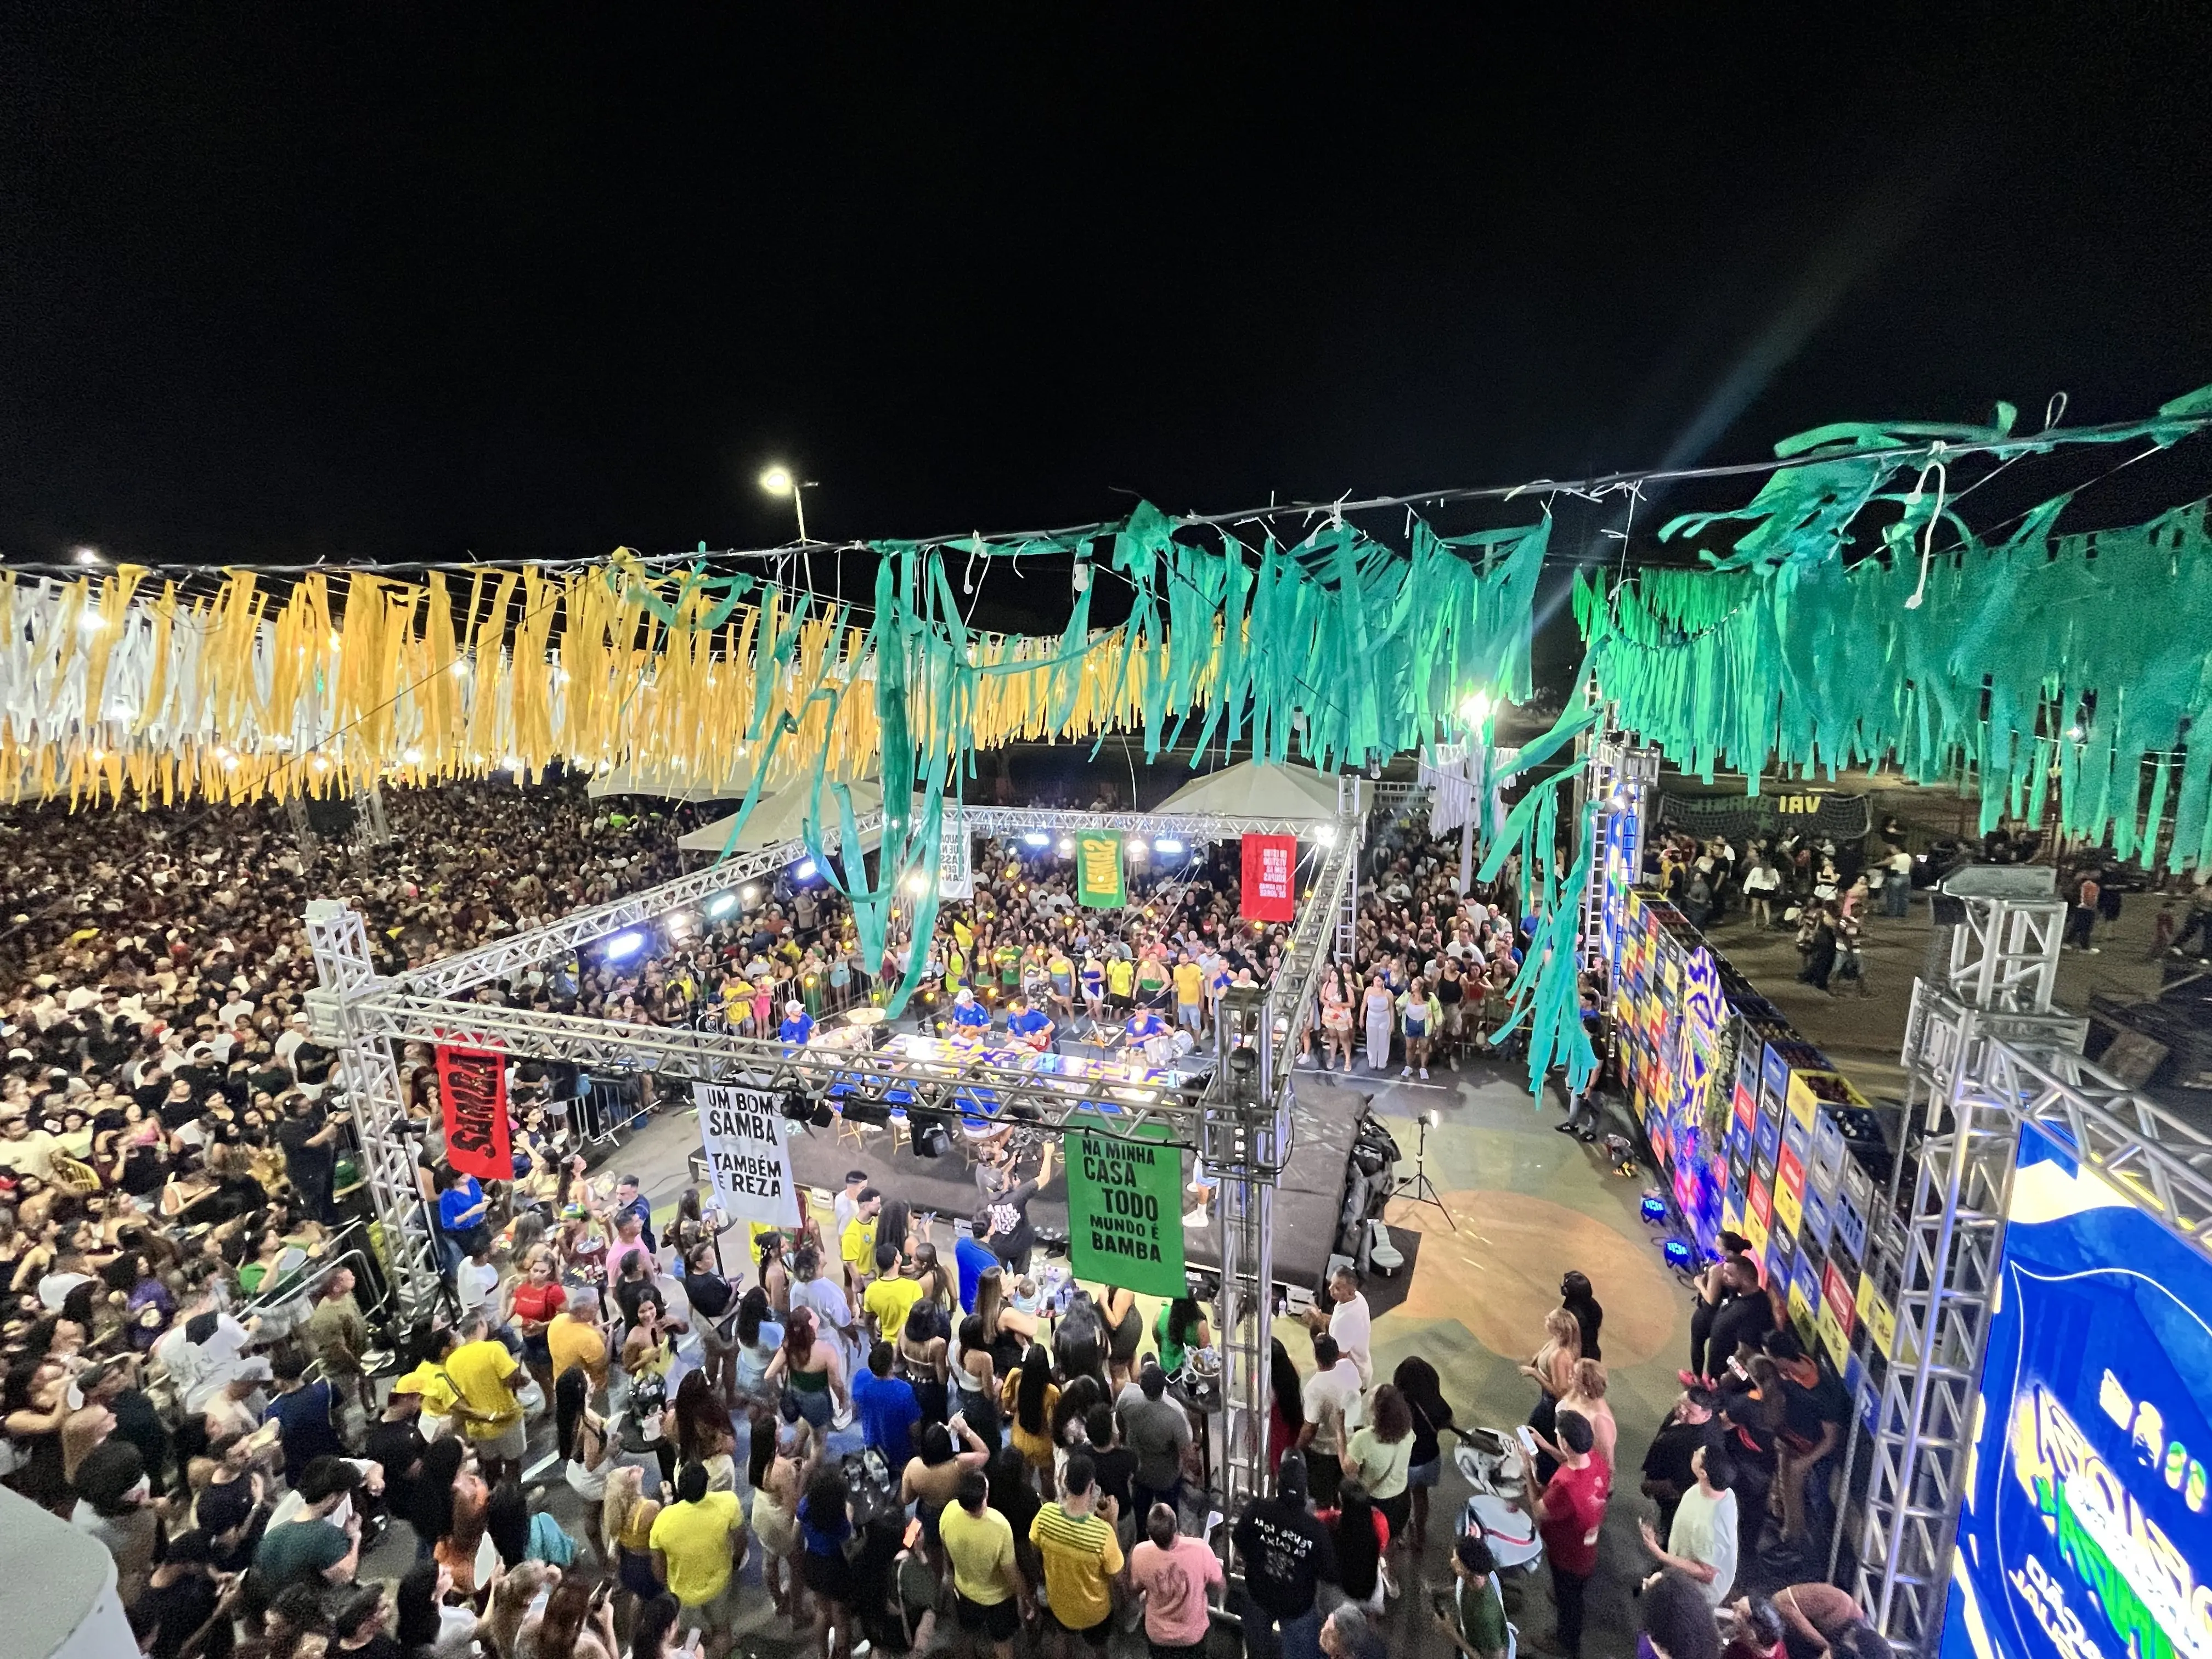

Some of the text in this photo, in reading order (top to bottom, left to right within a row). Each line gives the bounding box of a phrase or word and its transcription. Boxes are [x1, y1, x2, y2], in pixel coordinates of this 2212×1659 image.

[707, 1088, 774, 1116] UM BOM
[709, 1110, 778, 1146] SAMBA
[711, 1153, 782, 1177] TAMBÉM
[1082, 1139, 1155, 1166] NA MINHA
[716, 1172, 781, 1198] É REZA
[1083, 1157, 1137, 1187] CASA
[1102, 1187, 1159, 1221] TODO
[1090, 1214, 1160, 1240] MUNDO É
[1092, 1232, 1162, 1263] BAMBA
